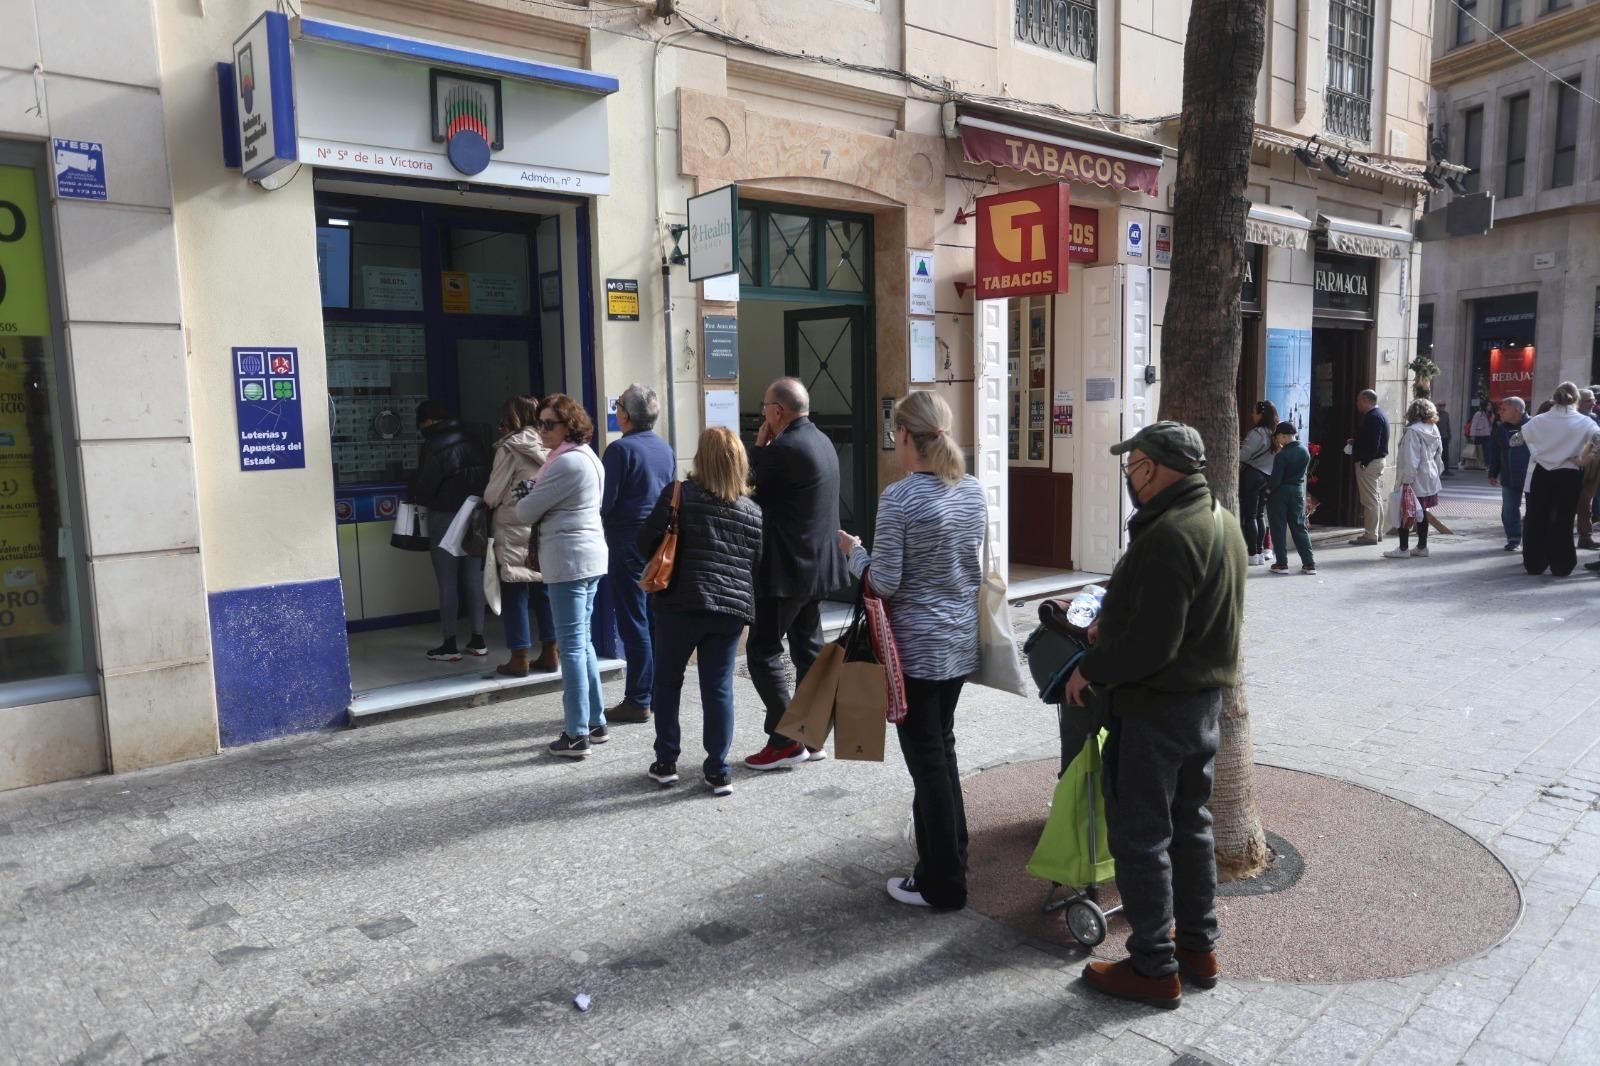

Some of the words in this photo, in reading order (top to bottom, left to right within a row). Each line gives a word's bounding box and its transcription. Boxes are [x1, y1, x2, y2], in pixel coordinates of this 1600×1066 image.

[55, 139, 101, 152] ITESA
[354, 152, 368, 163] de
[374, 153, 384, 165] la
[389, 155, 433, 170] Victoria
[820, 149, 831, 170] 7
[1005, 138, 1127, 185] TABACOS
[575, 177, 581, 187] 2
[699, 217, 732, 242] Health
[1338, 235, 1401, 258] FARMACIA
[982, 269, 1053, 291] TABACOS
[1315, 269, 1369, 297] FARMACIA
[1484, 312, 1536, 324] SKECHERS
[281, 431, 287, 440] y
[242, 443, 286, 454] Apuestas
[287, 442, 302, 450] del
[243, 456, 276, 466] Estado
